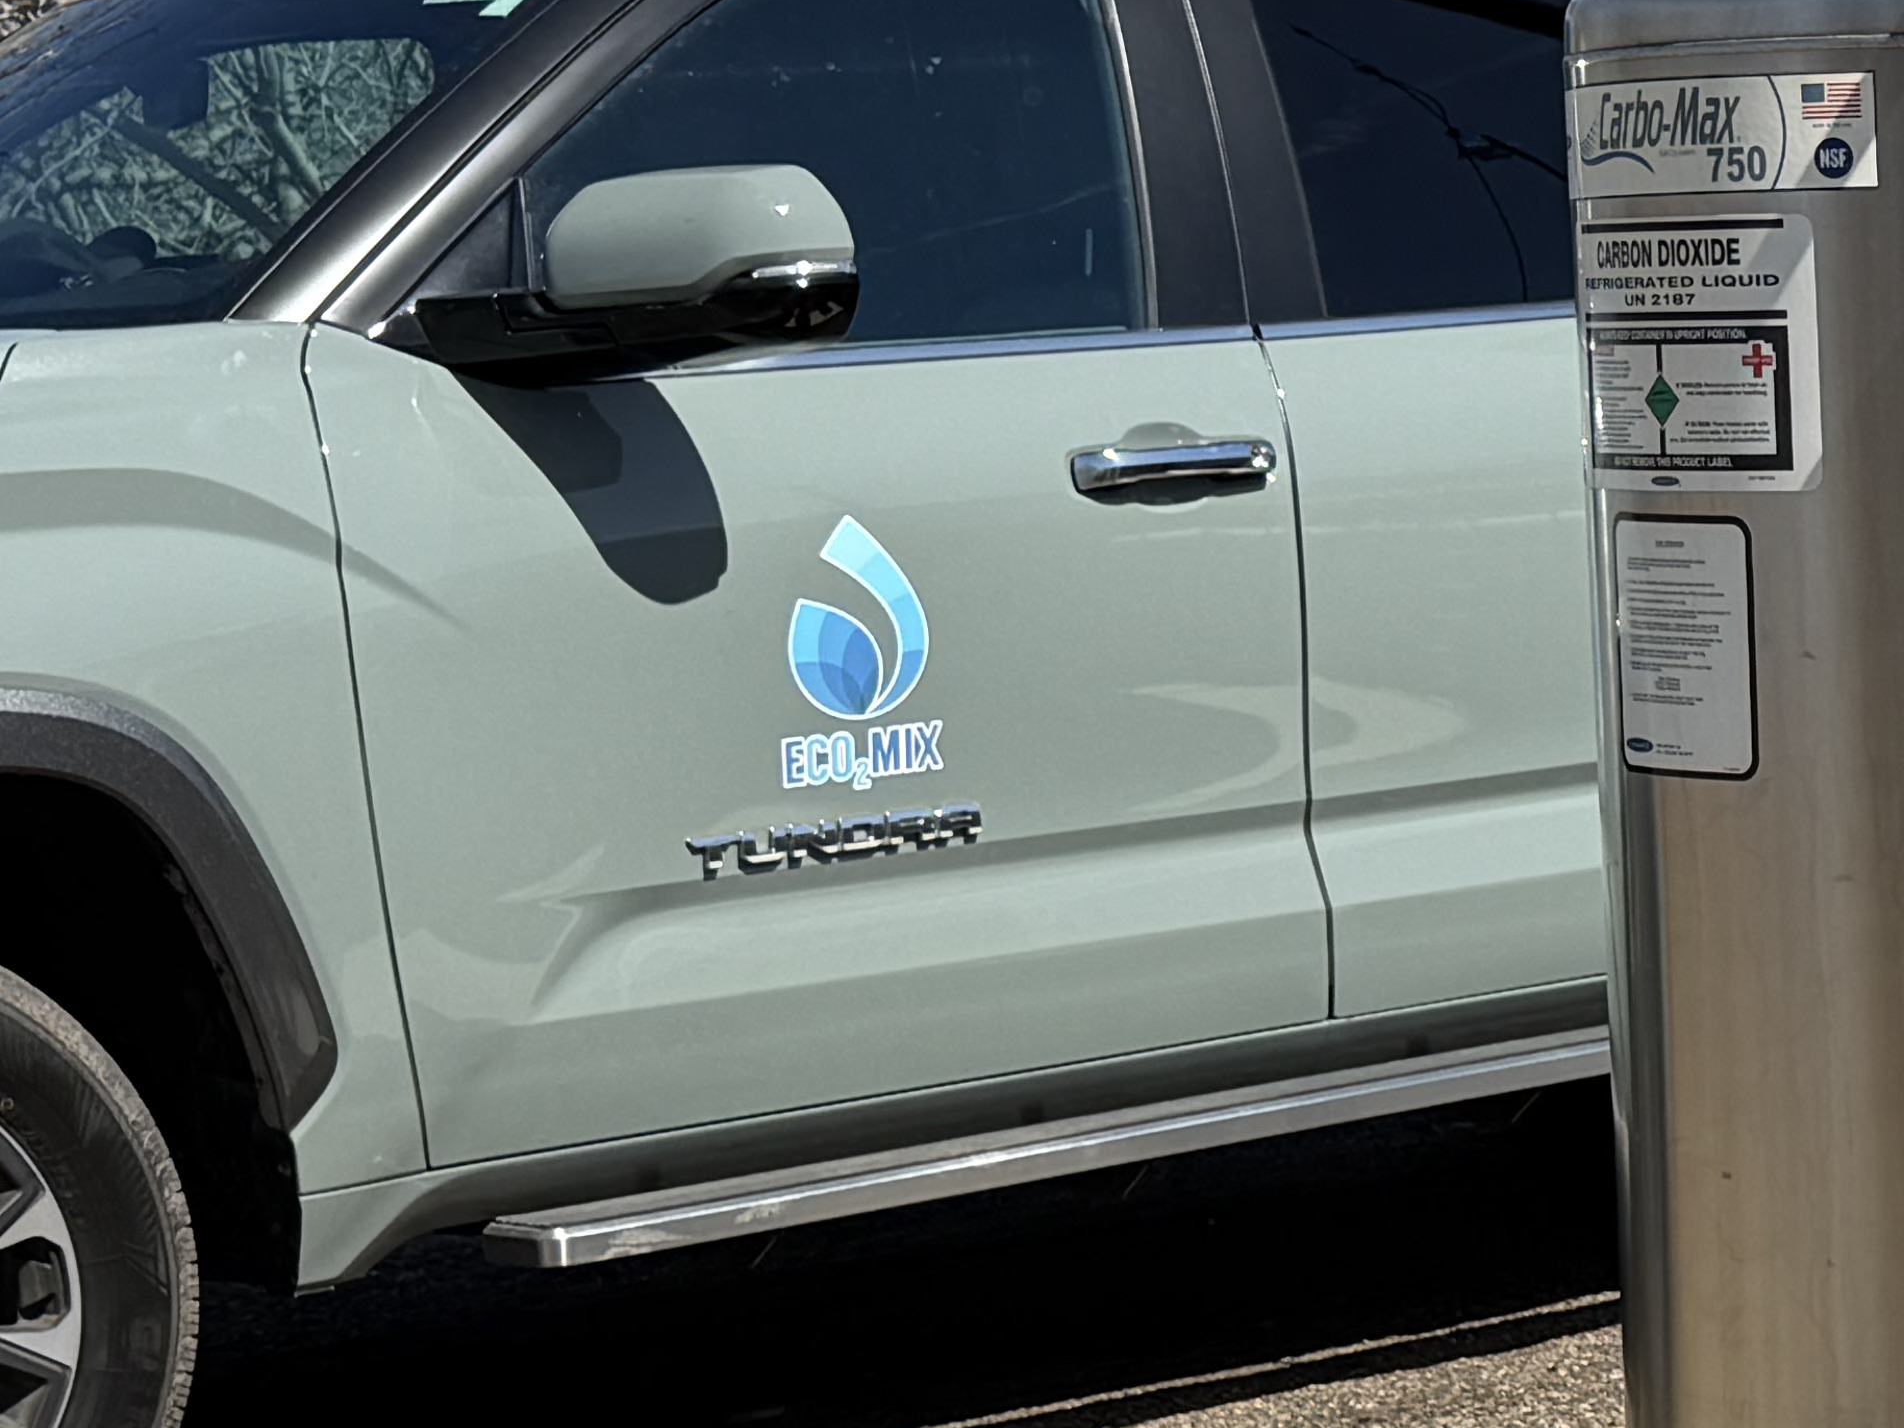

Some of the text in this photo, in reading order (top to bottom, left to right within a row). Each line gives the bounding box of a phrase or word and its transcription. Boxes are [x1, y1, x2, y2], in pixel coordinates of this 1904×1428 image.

[1600, 87, 1740, 150] Carbo-Max
[1707, 146, 1766, 183] 750
[1819, 148, 1847, 169] NSF
[1597, 238, 1741, 269] CARBON DIOXIDE
[1585, 274, 1780, 290] REFRIGERATED LIQUID
[1624, 293, 1695, 306] UN 2187
